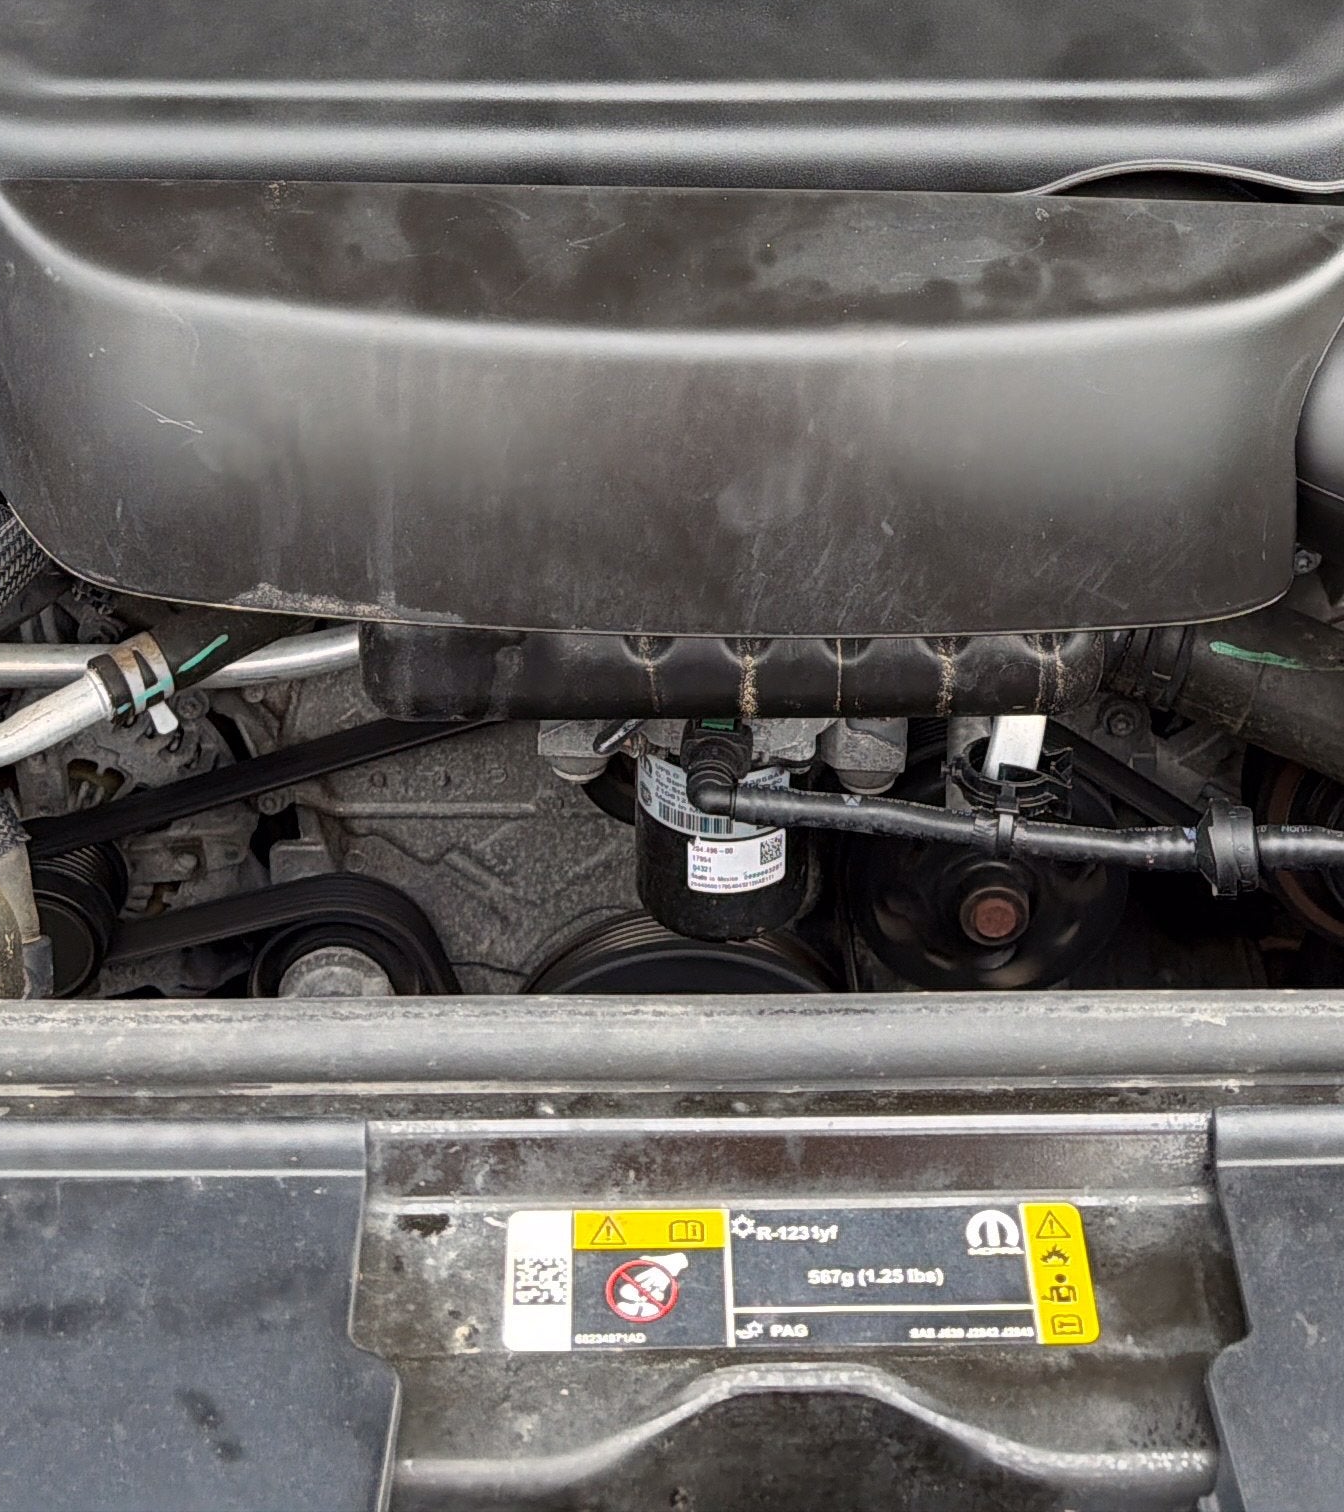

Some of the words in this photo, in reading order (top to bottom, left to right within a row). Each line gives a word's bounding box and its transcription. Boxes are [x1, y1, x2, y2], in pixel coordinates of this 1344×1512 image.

[858, 1268, 904, 1287] (1.25
[906, 1268, 944, 1286] lbs)
[769, 1324, 809, 1338] PAG
